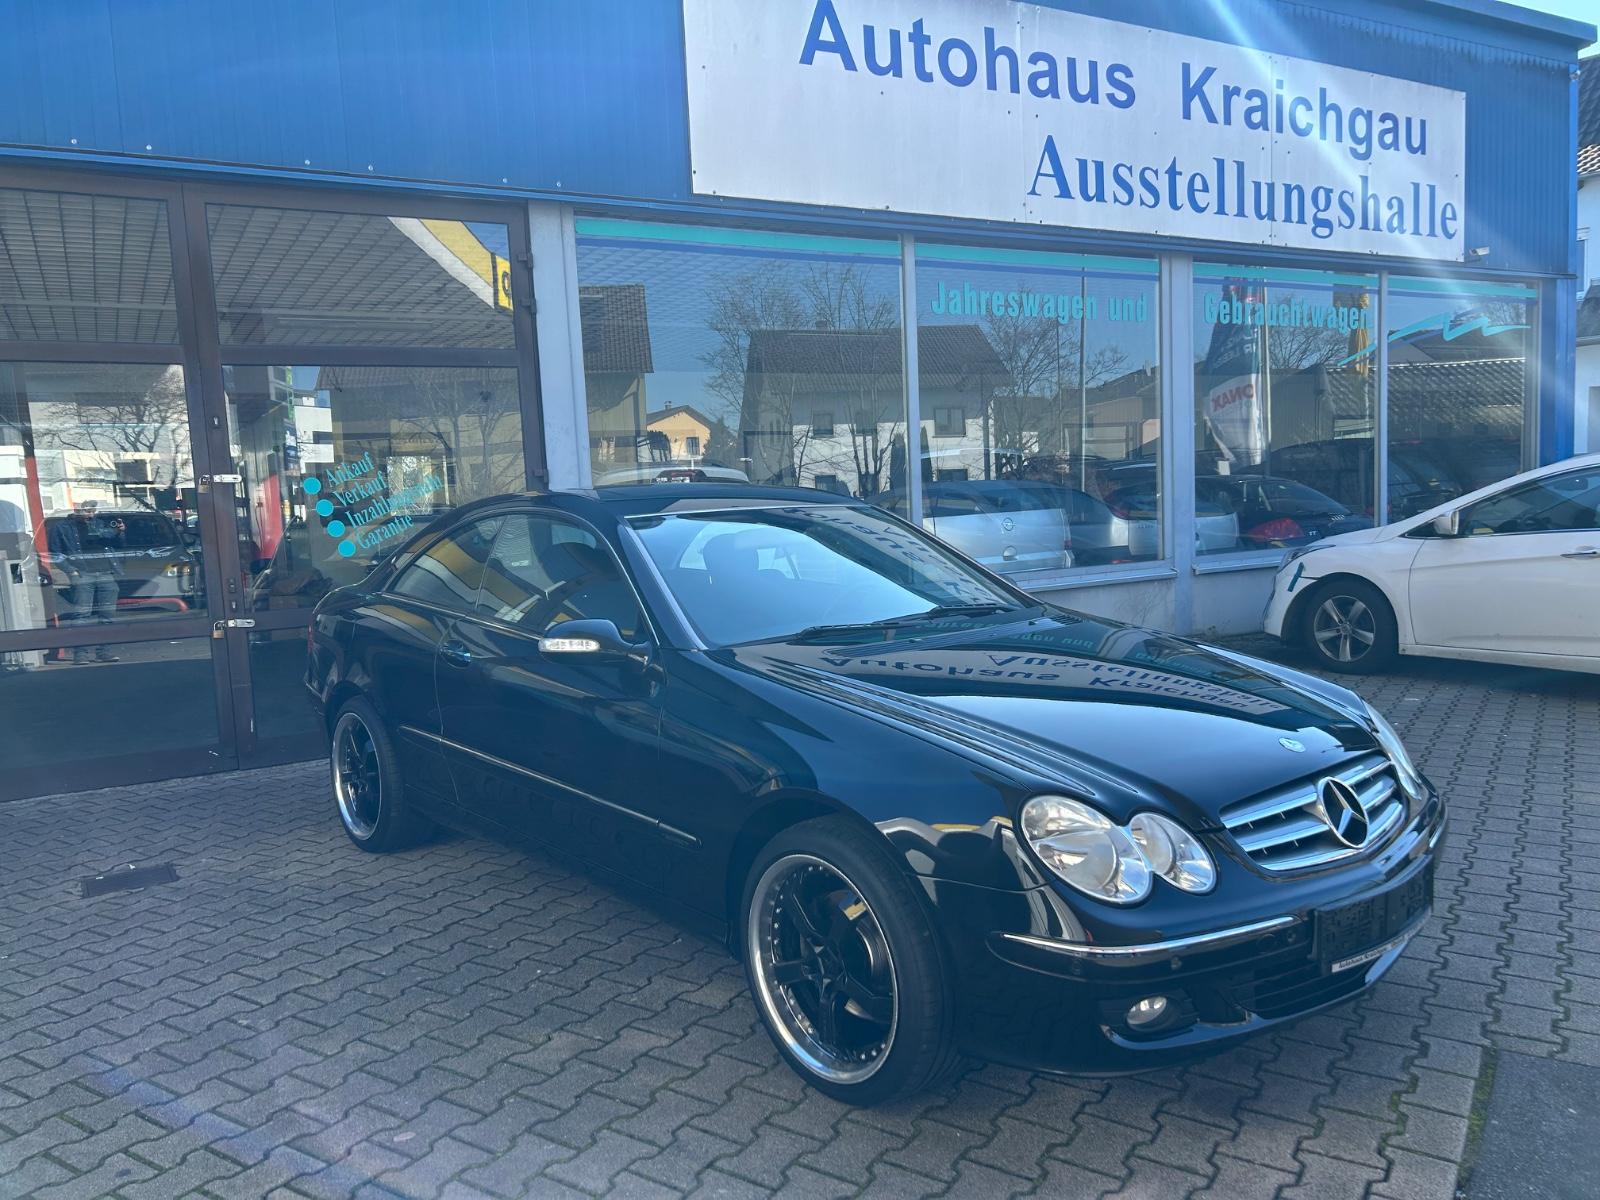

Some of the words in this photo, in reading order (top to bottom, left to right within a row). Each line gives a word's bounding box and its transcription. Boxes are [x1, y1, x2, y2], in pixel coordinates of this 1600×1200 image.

[799, 0, 1136, 109] Autohaus
[1181, 61, 1427, 161] Kraichgau
[1027, 134, 1458, 240] Ausstellungshalle
[930, 281, 1098, 324] Jahreswagen
[1108, 291, 1149, 323] und
[1203, 291, 1372, 334] Gebrauchtwagen
[325, 451, 375, 488] Ankauf
[333, 470, 389, 508] Verkauf
[356, 513, 414, 549] Garantie
